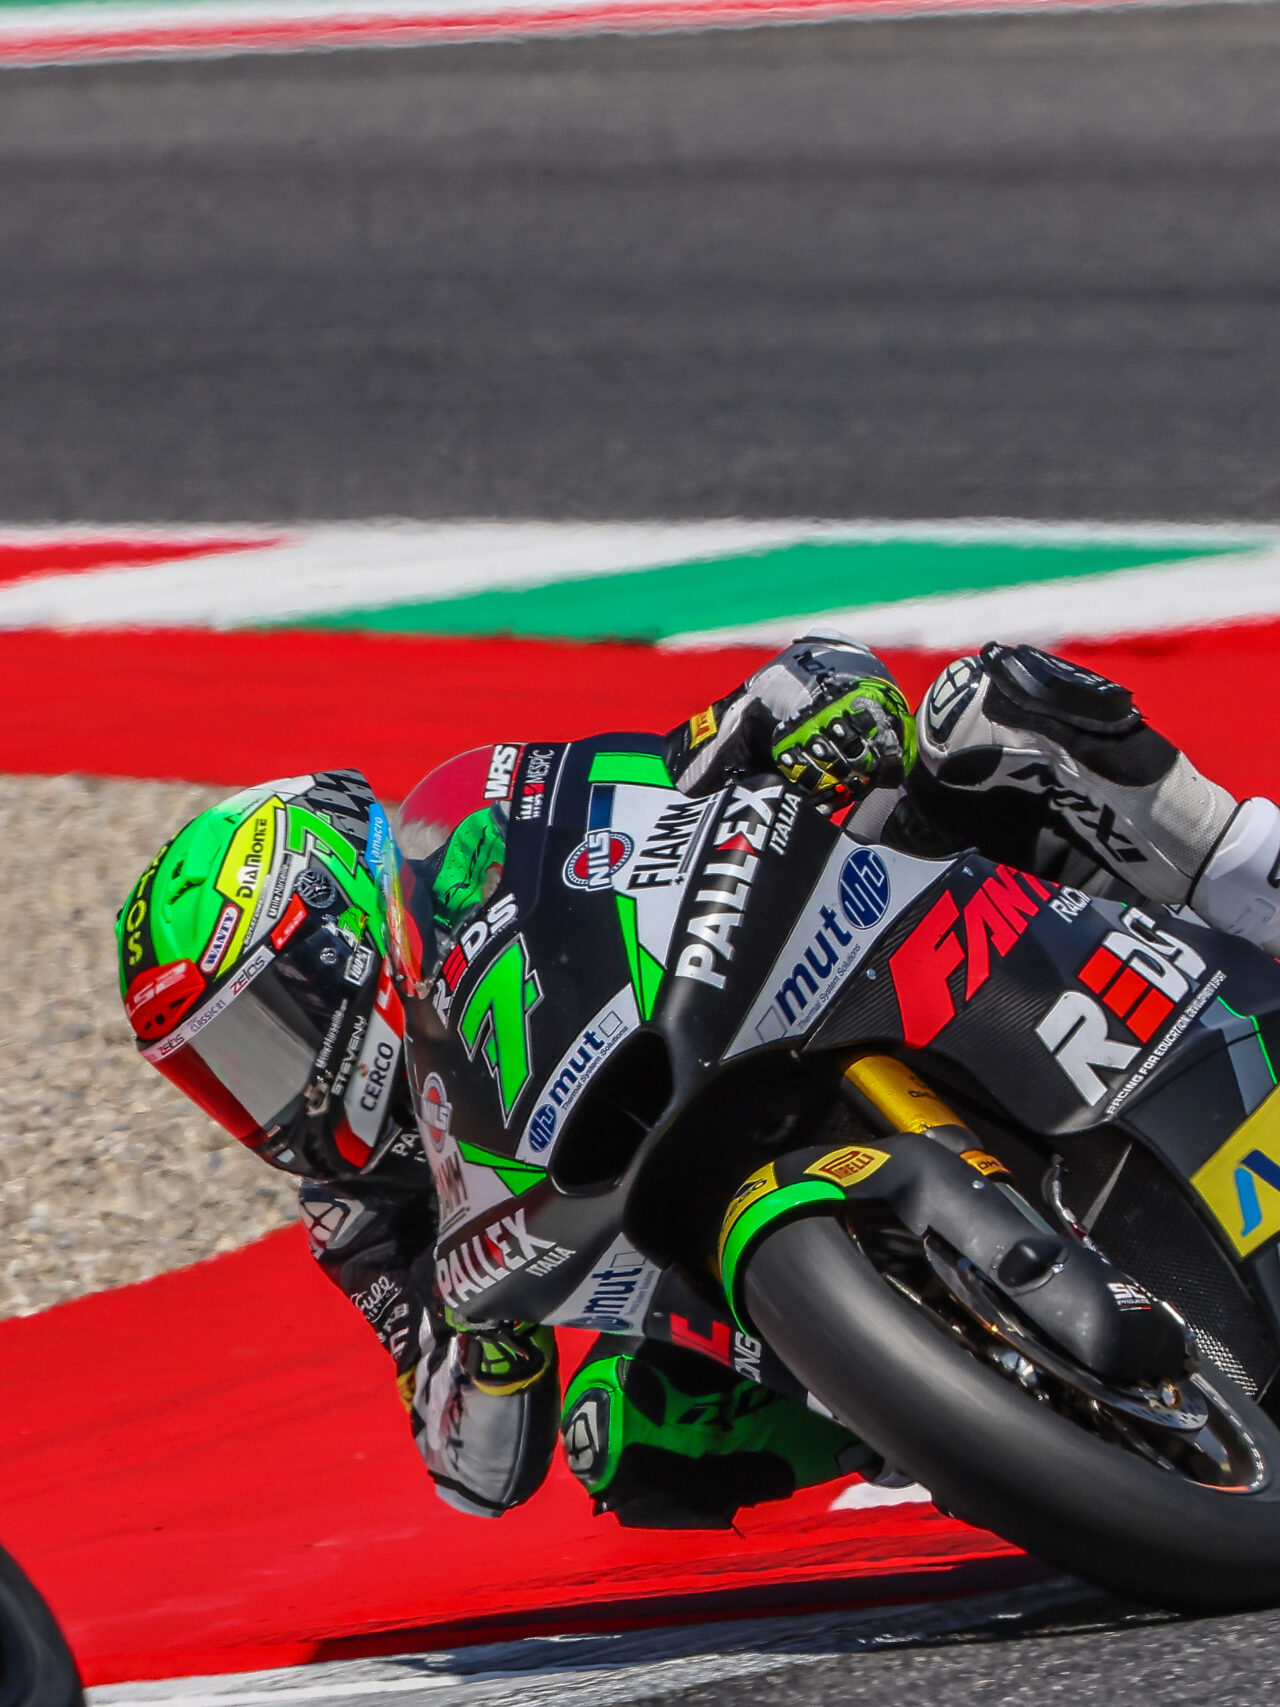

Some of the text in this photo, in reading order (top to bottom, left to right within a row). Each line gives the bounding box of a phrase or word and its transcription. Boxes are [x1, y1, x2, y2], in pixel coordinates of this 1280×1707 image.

[484, 744, 519, 799] WRS
[285, 803, 358, 876] 7
[588, 831, 611, 886] NILS
[627, 797, 711, 890] FIAMM
[768, 792, 801, 855] ITALIA
[675, 785, 785, 990] PALLEX
[206, 912, 235, 965] WANTY
[774, 904, 853, 1026] mut
[820, 974, 840, 1002] System
[838, 943, 861, 976] Solutions
[888, 864, 1061, 1047] FANT
[457, 931, 545, 1130] 7
[1034, 906, 1208, 1107] REDS
[331, 1015, 368, 1095] STEVENY
[361, 1041, 394, 1112] CERCO
[548, 1030, 605, 1107] mut
[580, 1056, 601, 1083] System
[599, 1025, 629, 1056] Solutions
[1106, 1074, 1145, 1116] RACING
[1139, 1055, 1161, 1076] FOR
[1153, 1014, 1190, 1057] EDUCATION
[818, 1150, 876, 1180] PIRELLI
[436, 1208, 556, 1309] PALLEX
[525, 1246, 577, 1277] ITALIA
[582, 1267, 643, 1314] mut
